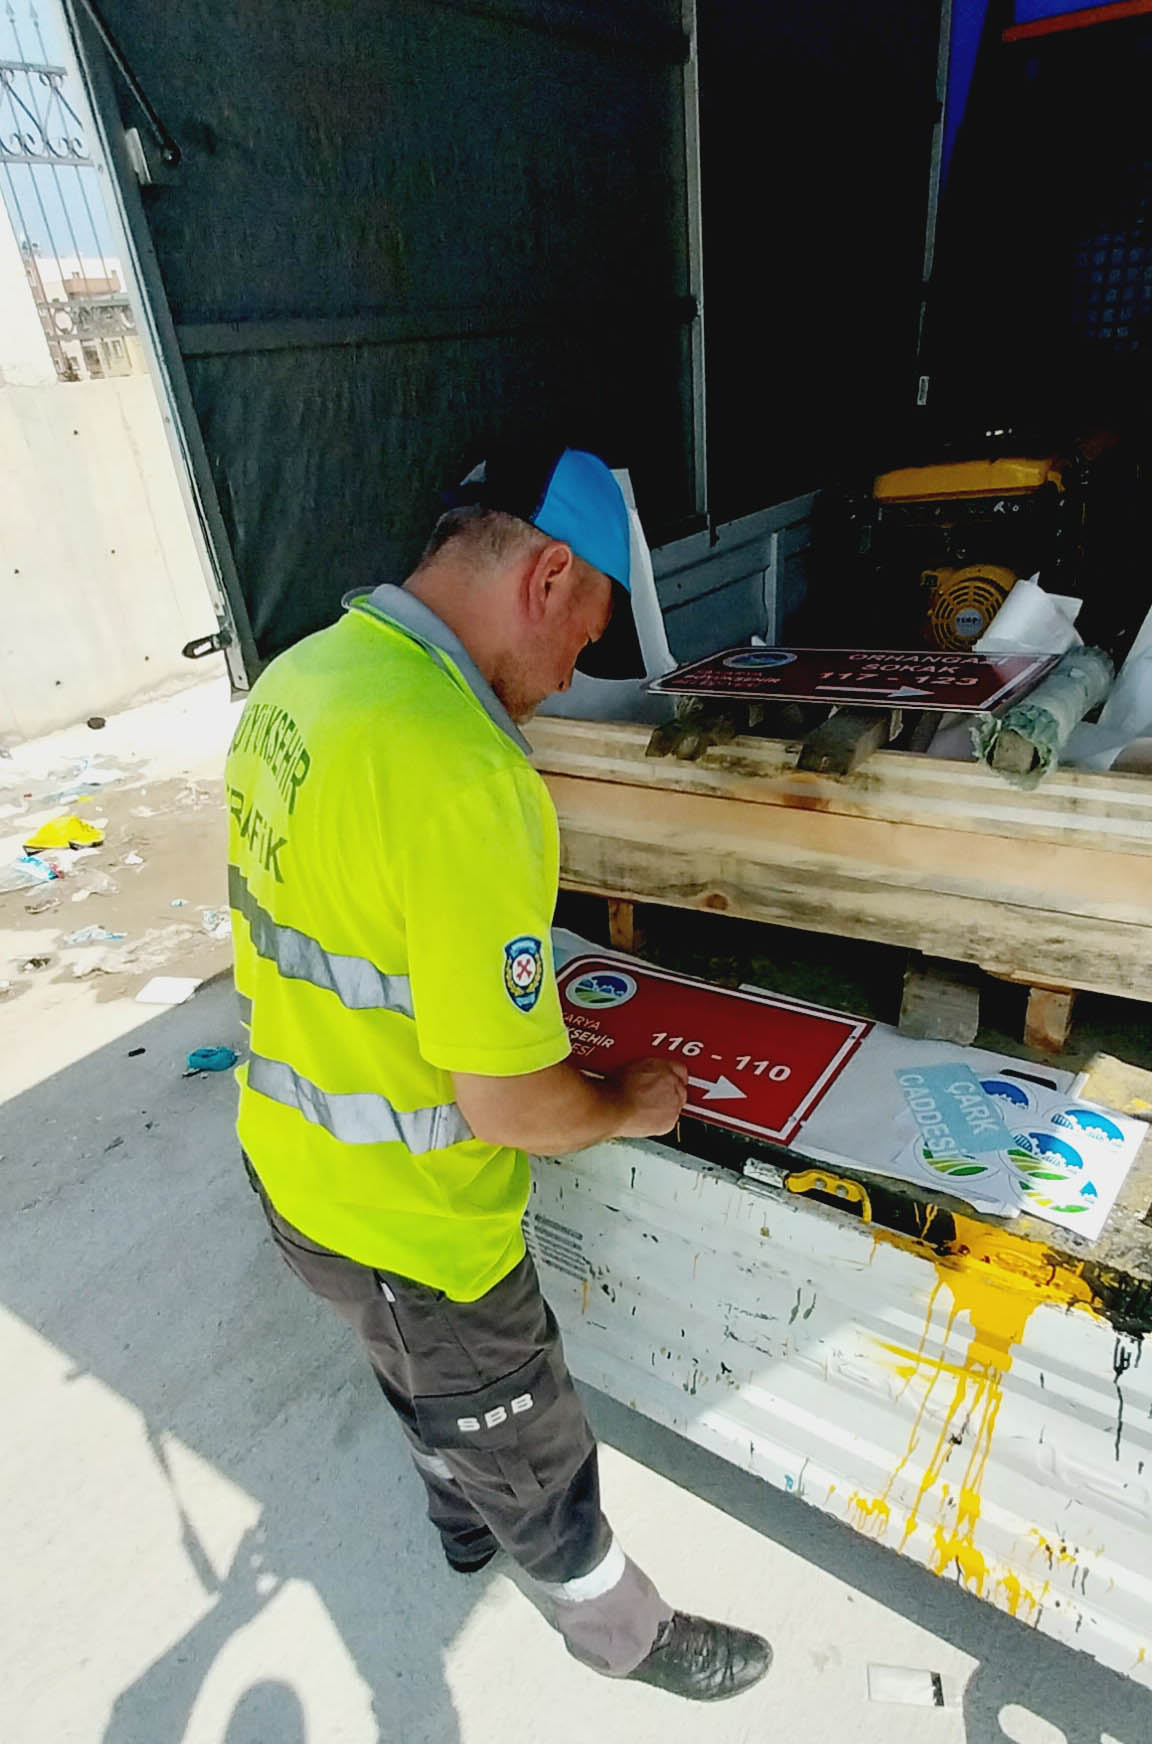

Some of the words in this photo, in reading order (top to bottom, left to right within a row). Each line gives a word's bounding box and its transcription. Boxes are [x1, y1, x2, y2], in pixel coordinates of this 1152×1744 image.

[816, 671, 881, 681] 117
[914, 675, 979, 686] 123
[861, 663, 961, 674] SOKAK
[227, 784, 288, 883] RAFİK
[650, 1031, 705, 1057] 116
[710, 1053, 724, 1061] -
[735, 1055, 792, 1082] 110
[899, 1074, 967, 1158] CADDESİ
[457, 1393, 534, 1431] SBB
